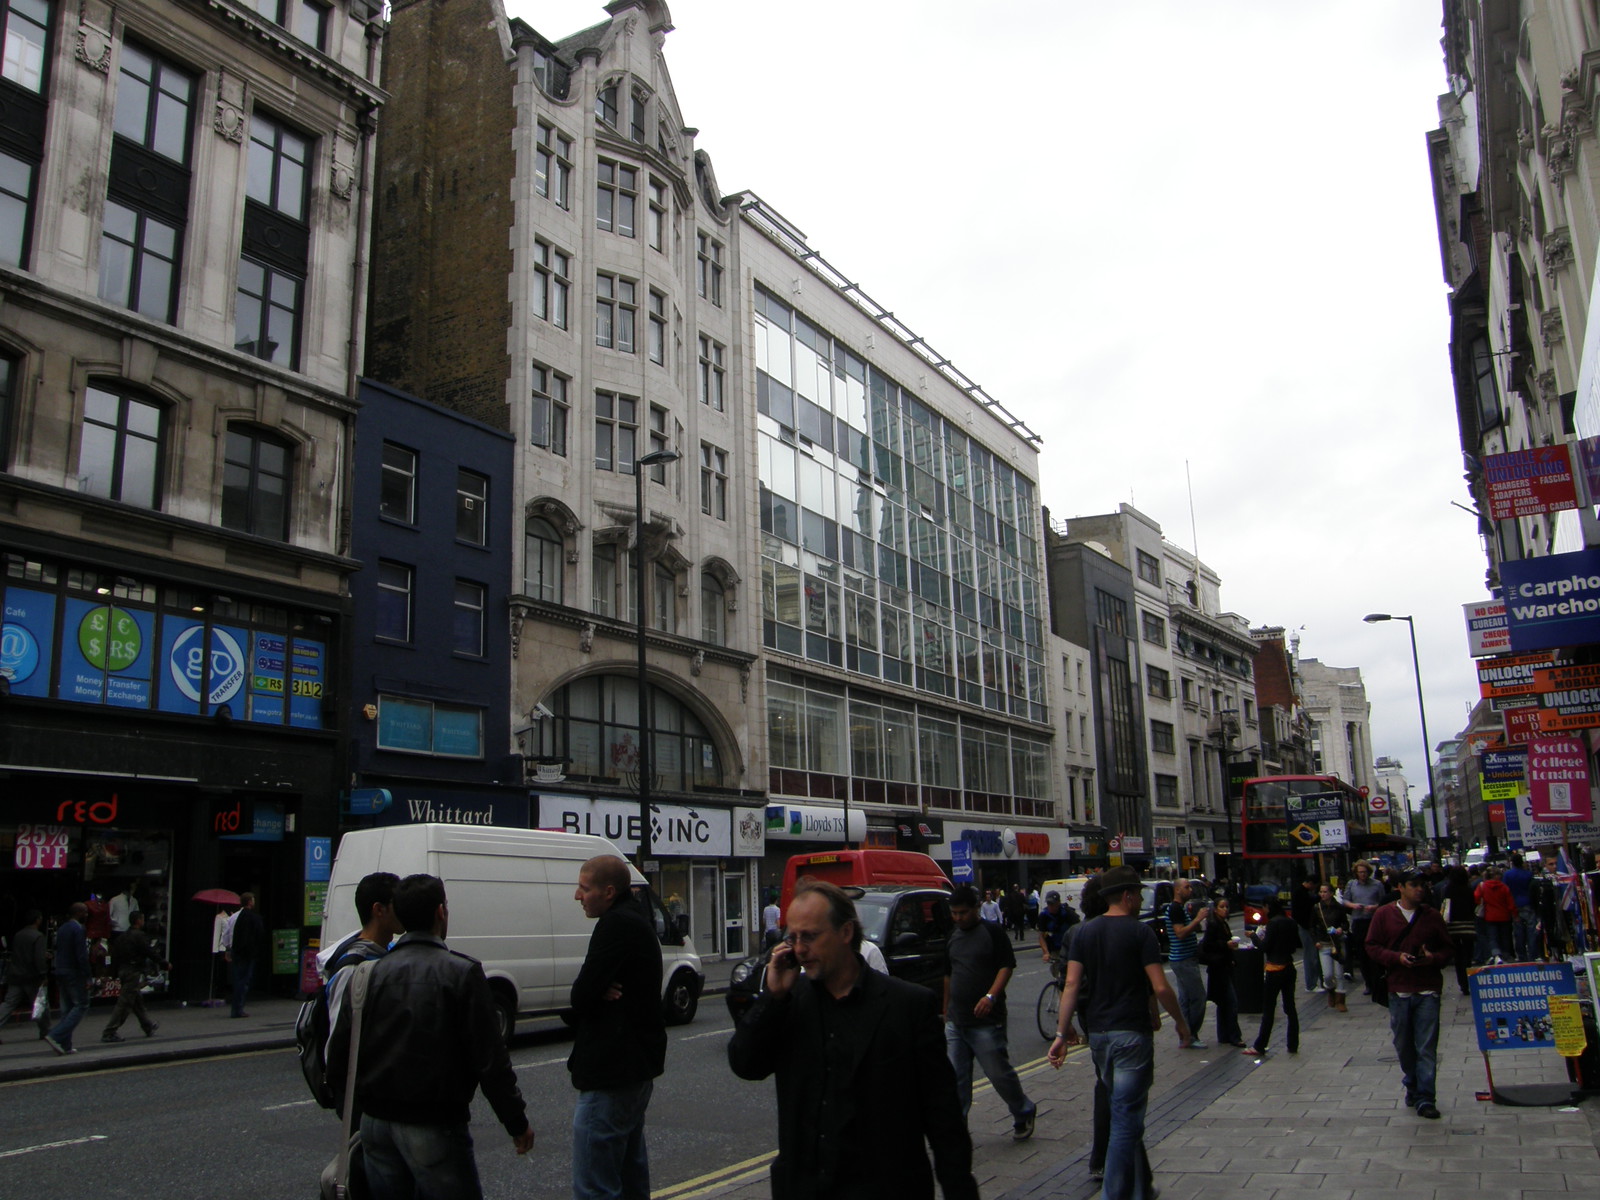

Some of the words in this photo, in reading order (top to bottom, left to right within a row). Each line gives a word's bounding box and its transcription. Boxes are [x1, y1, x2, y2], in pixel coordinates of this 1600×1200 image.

[1486, 450, 1535, 469] MOBILE
[1486, 460, 1566, 482] UNLOCKING
[1540, 473, 1570, 484] FASCIAS
[1514, 497, 1540, 506] CARDS
[1515, 504, 1546, 516] CALLING
[1550, 500, 1575, 511] CARDS
[1508, 584, 1518, 600] THE
[5, 606, 26, 618] Café
[1474, 607, 1486, 616] NO
[1472, 618, 1504, 630] BUREAU
[1481, 638, 1507, 648] ALWAYS
[76, 674, 103, 688] Money
[108, 678, 140, 690] Transfer
[211, 670, 243, 702] TRANSFER
[270, 680, 282, 690] R$
[75, 686, 102, 698] Money
[108, 690, 146, 702] Exchange
[1501, 686, 1525, 694] OXFORD
[1559, 706, 1586, 715] REPAIRS
[1562, 716, 1596, 726] OXFORD
[1534, 743, 1578, 754] Scott's
[1532, 757, 1584, 768] College
[1532, 769, 1586, 780] London
[56, 792, 118, 824] red
[408, 800, 494, 824] Whittard
[214, 800, 240, 832] red
[562, 812, 641, 840] BLUE
[668, 818, 710, 843] INC
[805, 814, 832, 836] Lloyds
[16, 824, 69, 846] 25%
[16, 845, 68, 868] OFF
[1476, 974, 1492, 986] WE
[1494, 972, 1506, 984] DO
[1508, 970, 1562, 983] UNLOCKING
[1478, 987, 1514, 1000] MOBILE
[1516, 985, 1547, 997] PHONE
[1548, 986, 1556, 995] &
[1482, 999, 1547, 1013] ACCESSORIES
